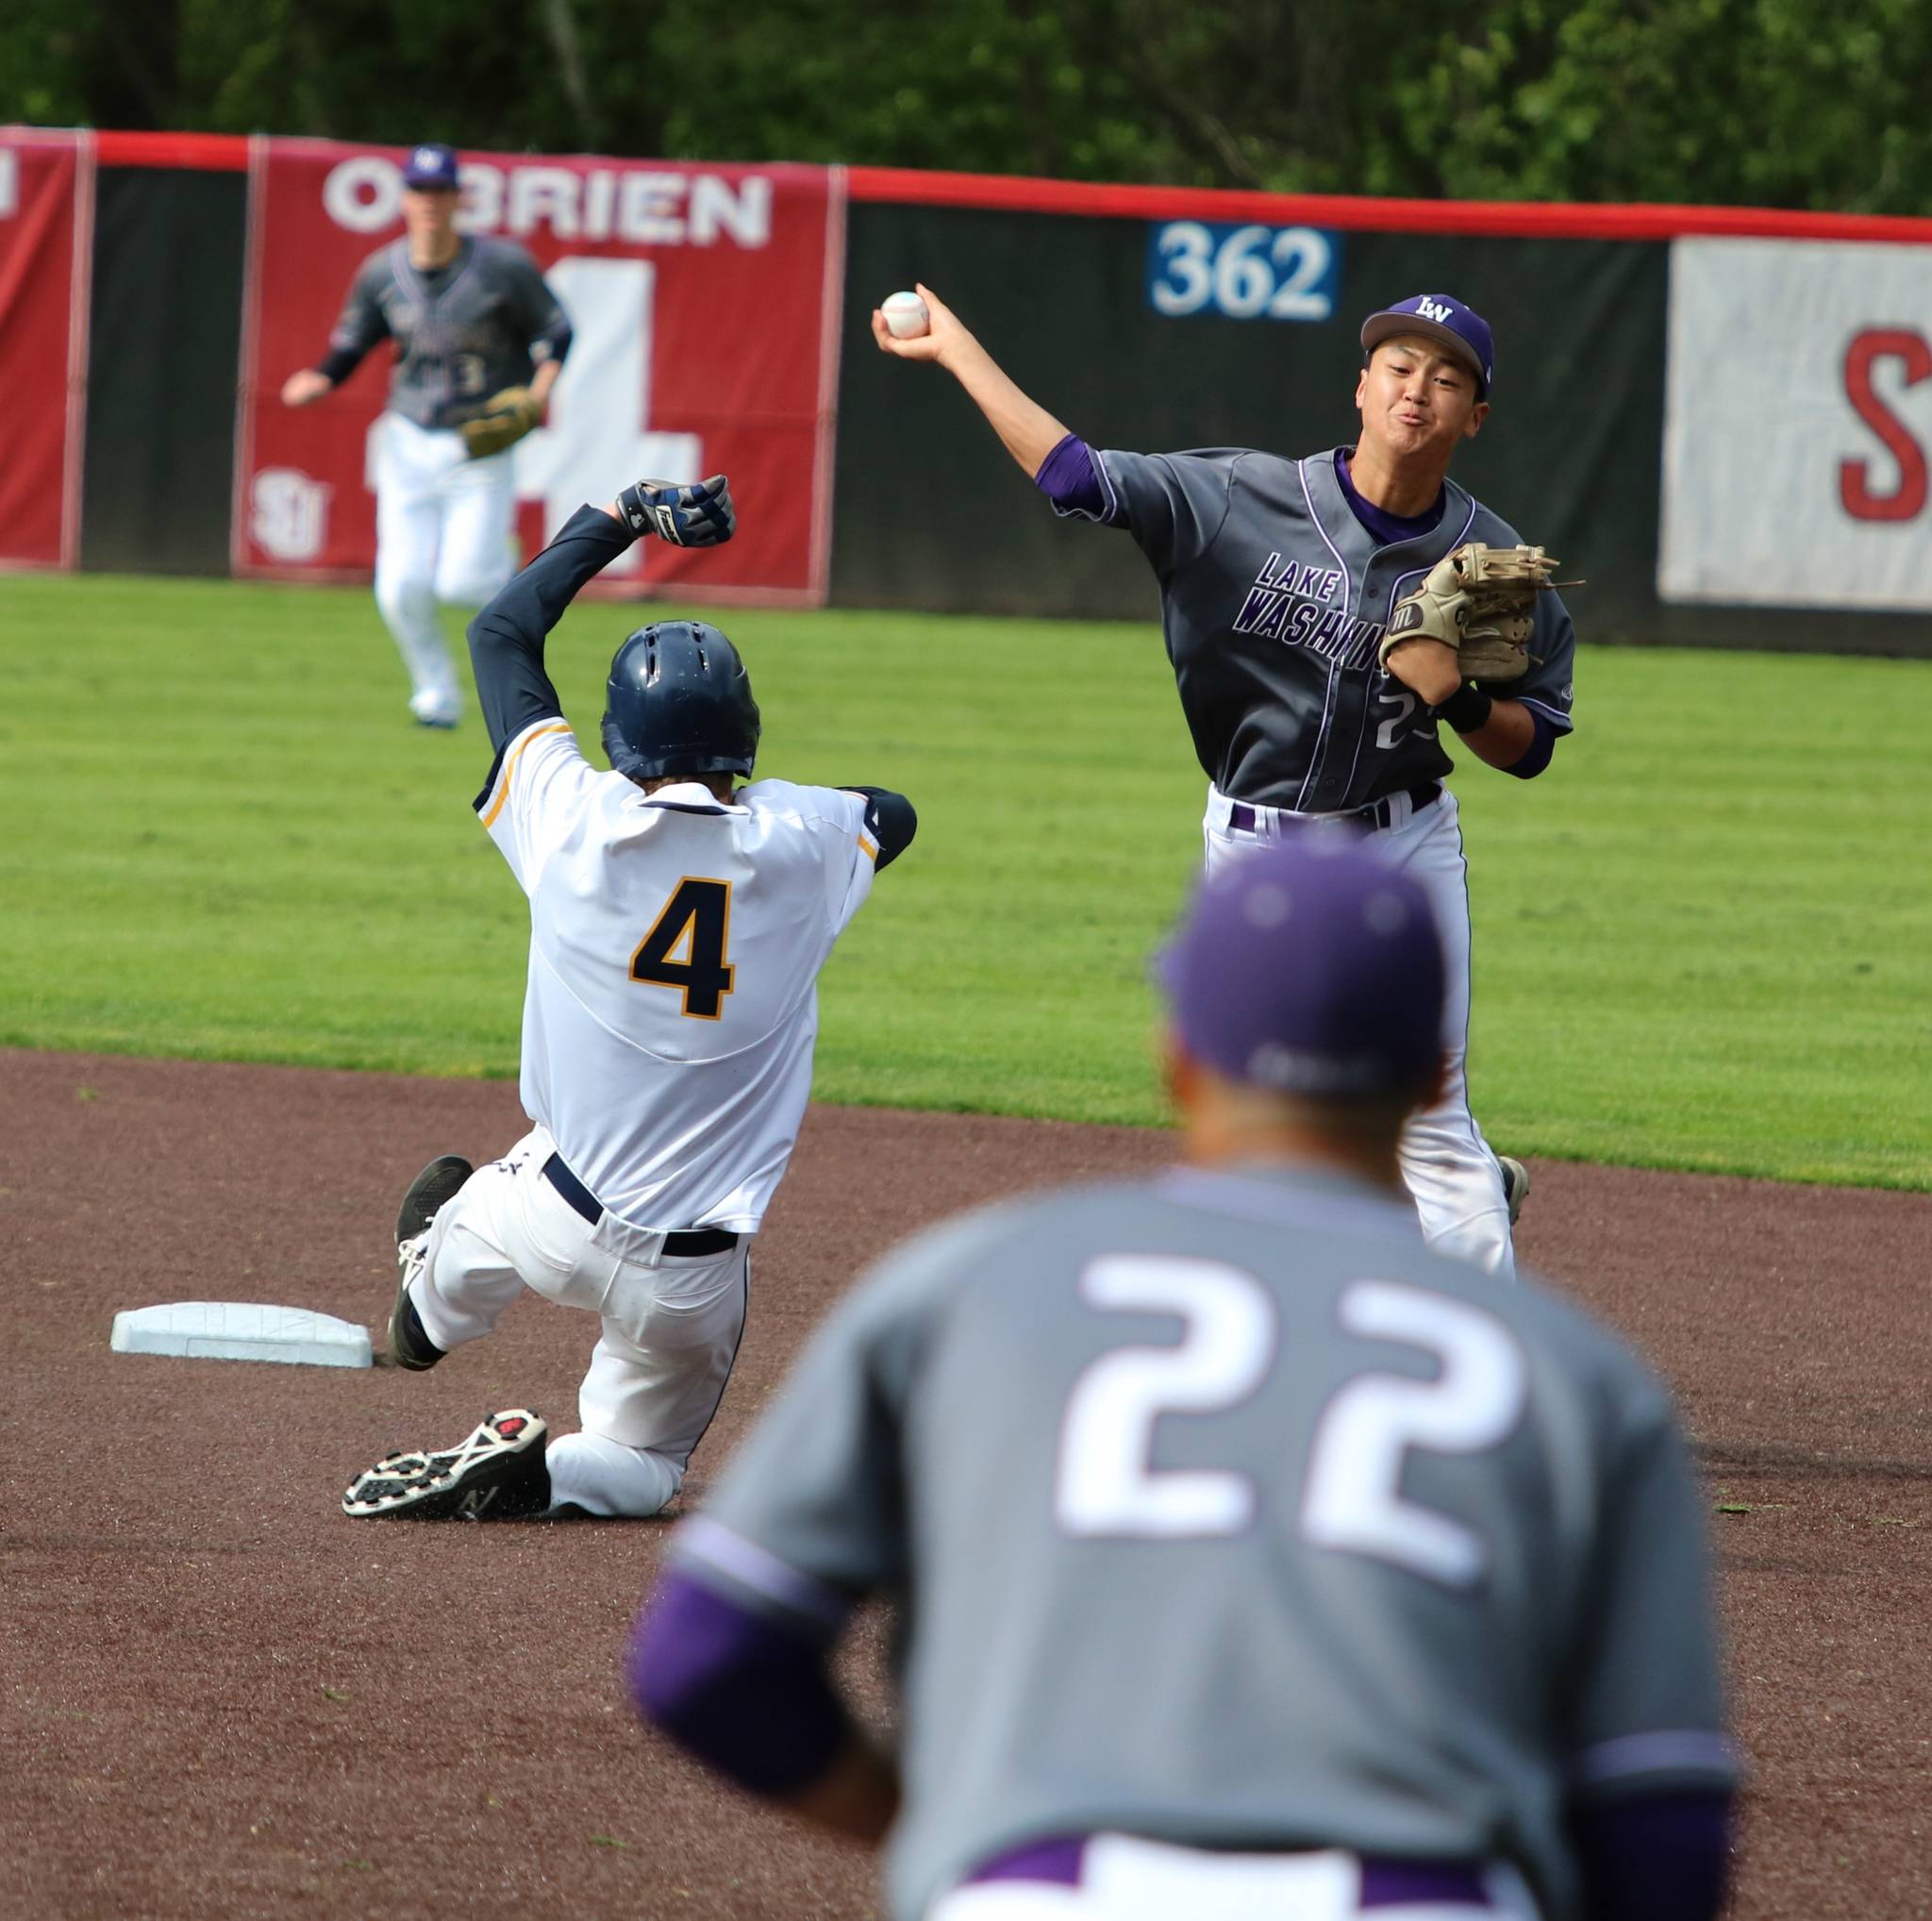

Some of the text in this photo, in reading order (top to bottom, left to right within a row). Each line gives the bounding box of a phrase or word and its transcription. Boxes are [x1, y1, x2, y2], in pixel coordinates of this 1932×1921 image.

[322, 157, 772, 248] OBRIEN
[1152, 220, 1332, 321] 362
[1415, 296, 1454, 324] LW
[1840, 326, 1932, 524] S
[1255, 551, 1341, 603] LAKE
[1232, 587, 1391, 677] WASHIN
[1374, 693, 1437, 750] 2
[628, 876, 736, 1021] 4
[1056, 1252, 1528, 1589] 22
